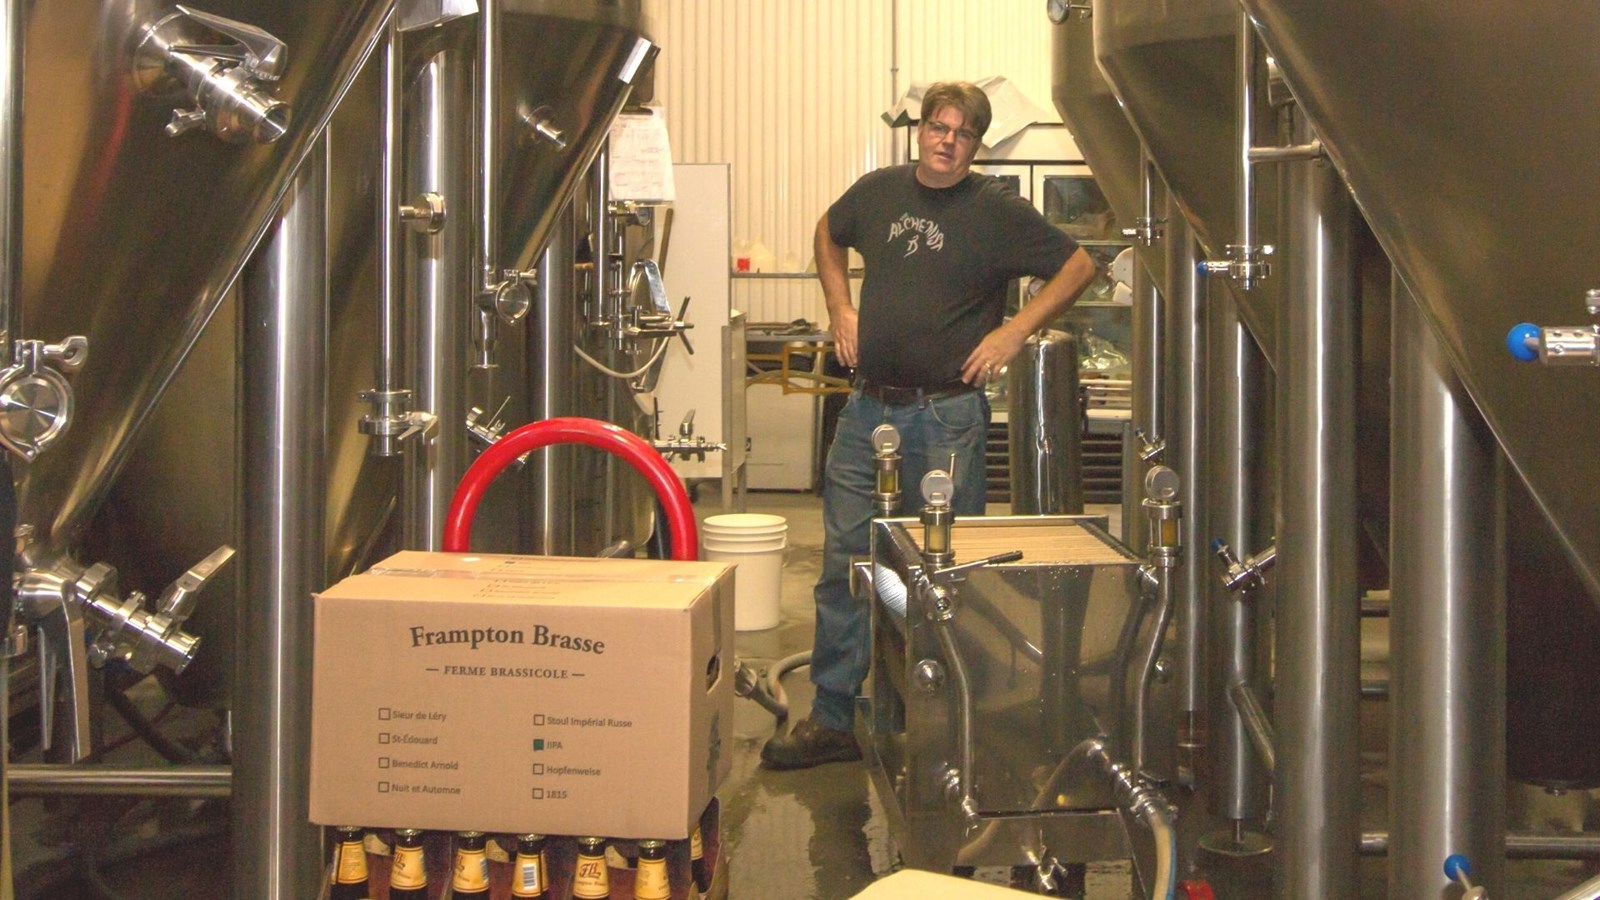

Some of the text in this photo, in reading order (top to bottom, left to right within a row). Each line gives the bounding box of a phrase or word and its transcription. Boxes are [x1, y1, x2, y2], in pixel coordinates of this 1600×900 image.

[409, 624, 605, 654] Frampton Brasse
[444, 665, 568, 679] FERME BRASSICOLE
[392, 710, 447, 721] Sieur de Léry
[571, 717, 606, 728] Impérial
[608, 719, 633, 728] Russe
[392, 733, 438, 745] St-Édouard
[392, 759, 459, 770] Benedict Arnold
[391, 784, 462, 795] Nuit et Automne
[546, 790, 568, 800] 1815
